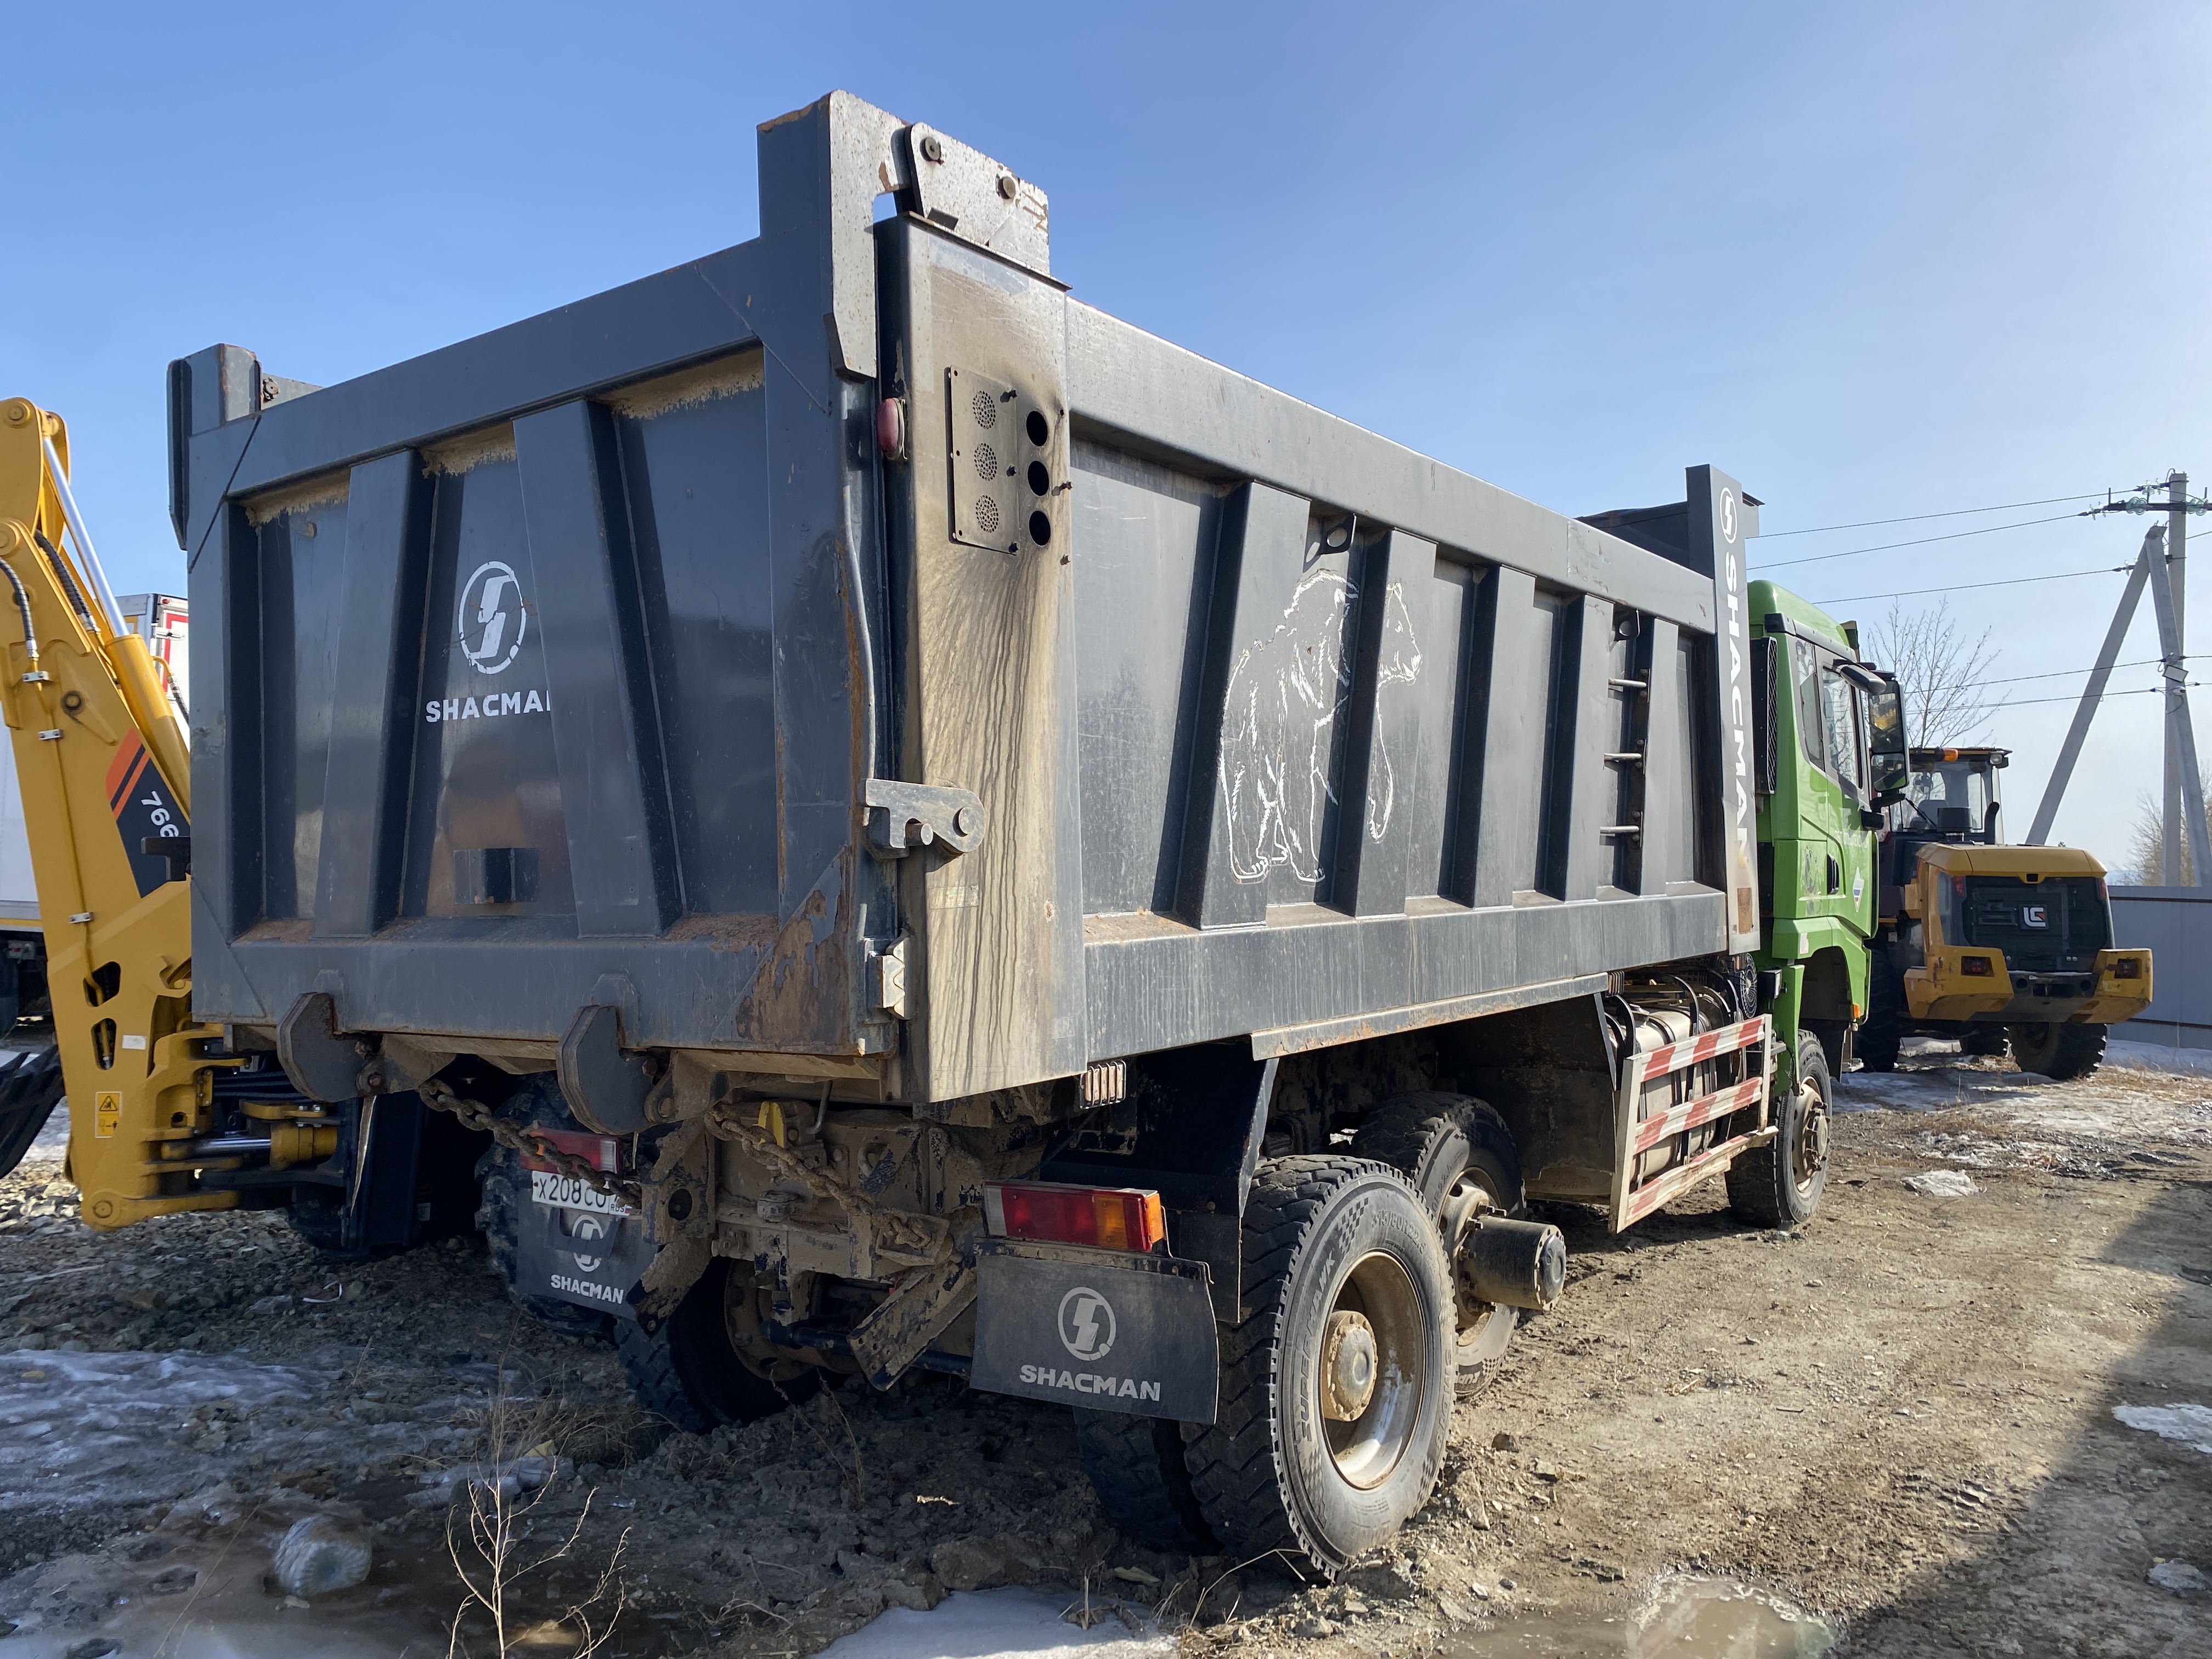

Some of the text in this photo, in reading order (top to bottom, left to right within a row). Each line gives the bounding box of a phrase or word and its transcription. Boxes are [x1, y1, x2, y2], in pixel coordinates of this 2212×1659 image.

[1725, 551, 1748, 869] SHACMAN
[610, 1203, 625, 1212] RUS
[550, 1274, 624, 1305] SHACMAN
[1019, 1364, 1161, 1402] SHACMAN
